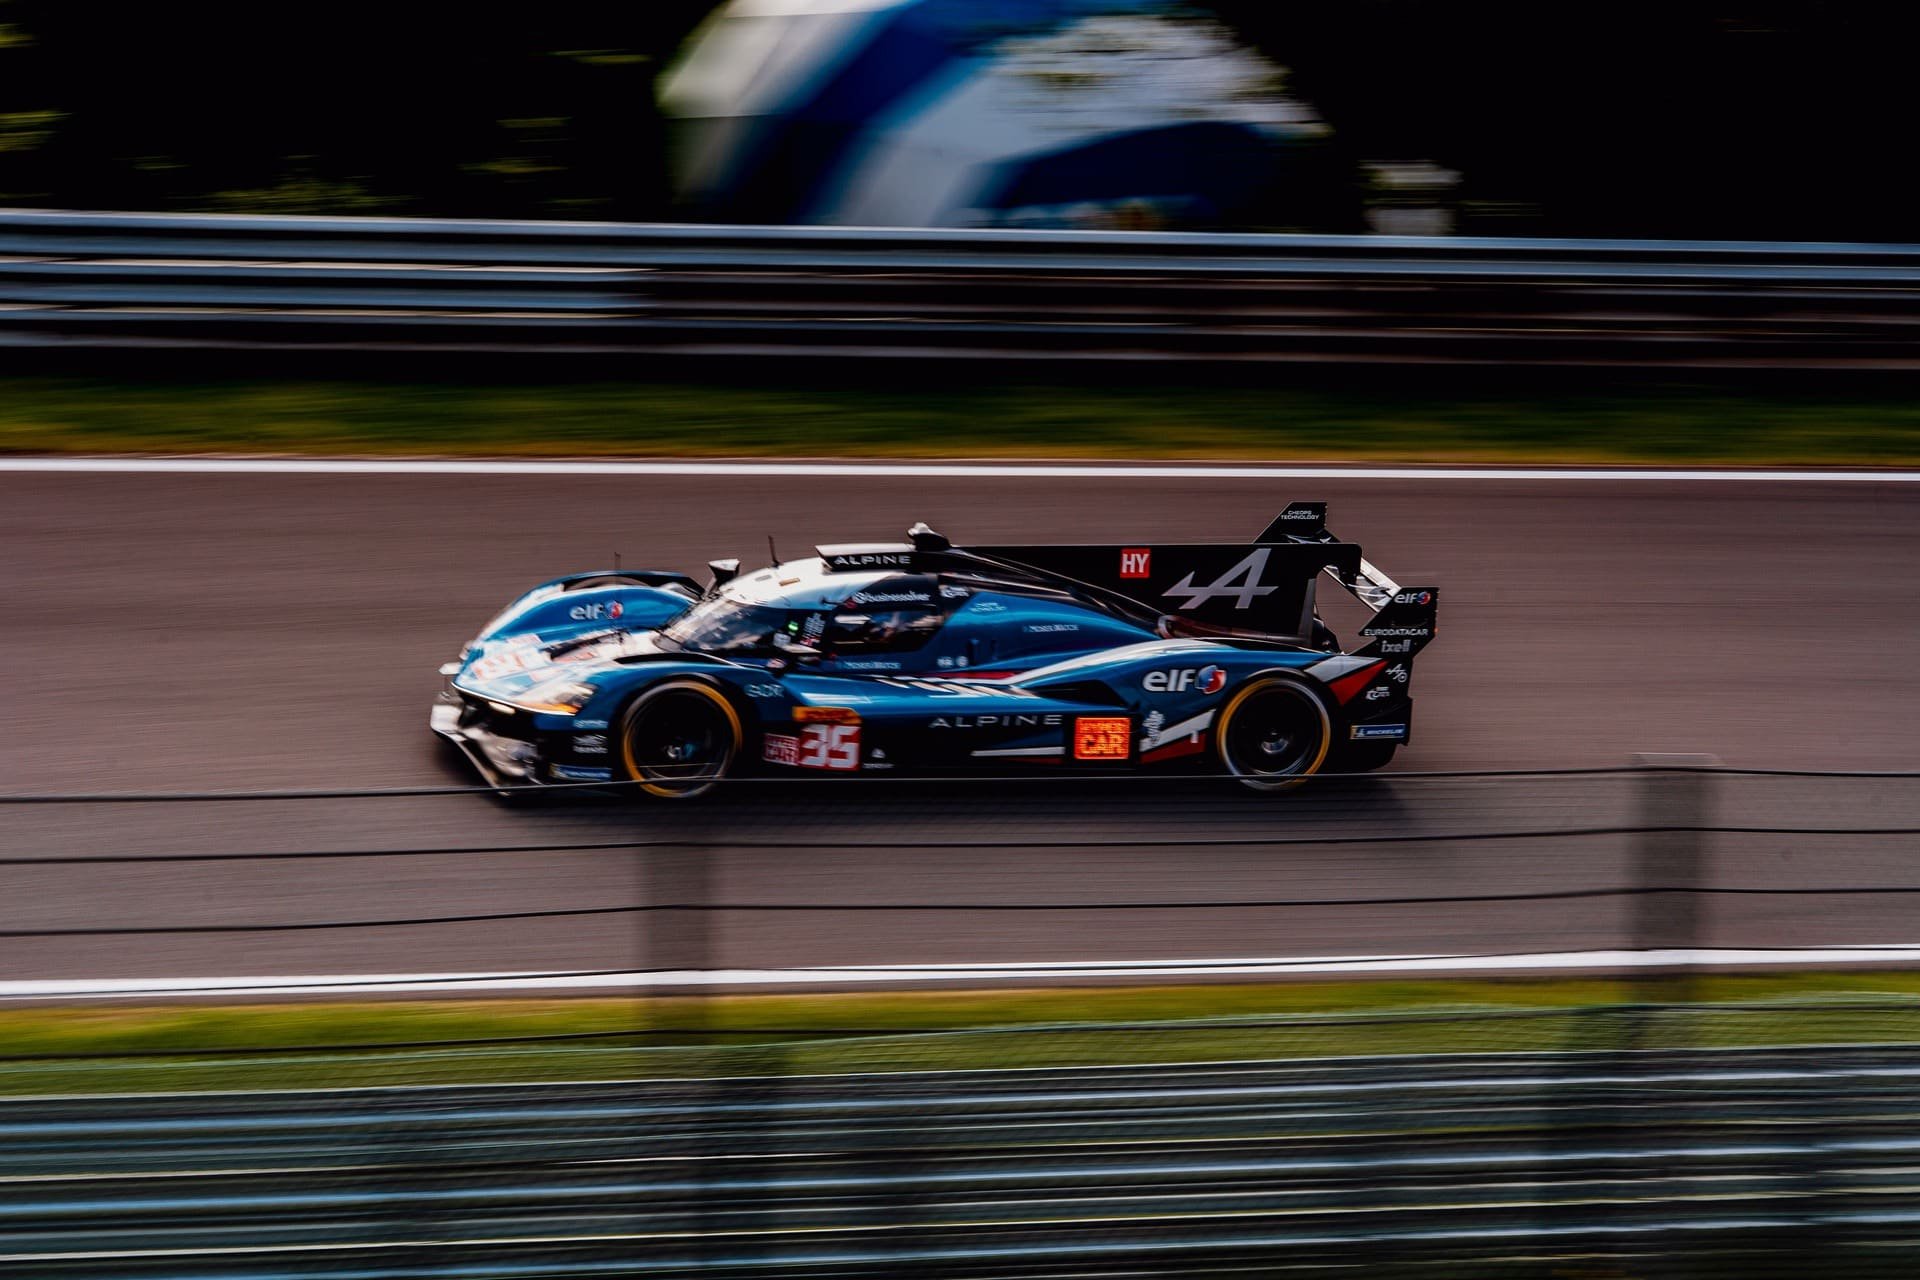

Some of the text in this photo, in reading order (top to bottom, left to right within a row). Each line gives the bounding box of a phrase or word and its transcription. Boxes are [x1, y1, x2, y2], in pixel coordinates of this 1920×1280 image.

[834, 555, 911, 565] ALPINE
[1121, 553, 1149, 574] HY
[1394, 592, 1418, 604] elf
[569, 602, 604, 620] elf
[1364, 628, 1429, 636] EURODATACAR
[1381, 639, 1411, 653] ixell
[1142, 668, 1197, 692] elf
[929, 714, 1063, 728] ALPINE
[801, 724, 861, 769] 35
[1080, 734, 1123, 754] CAR
